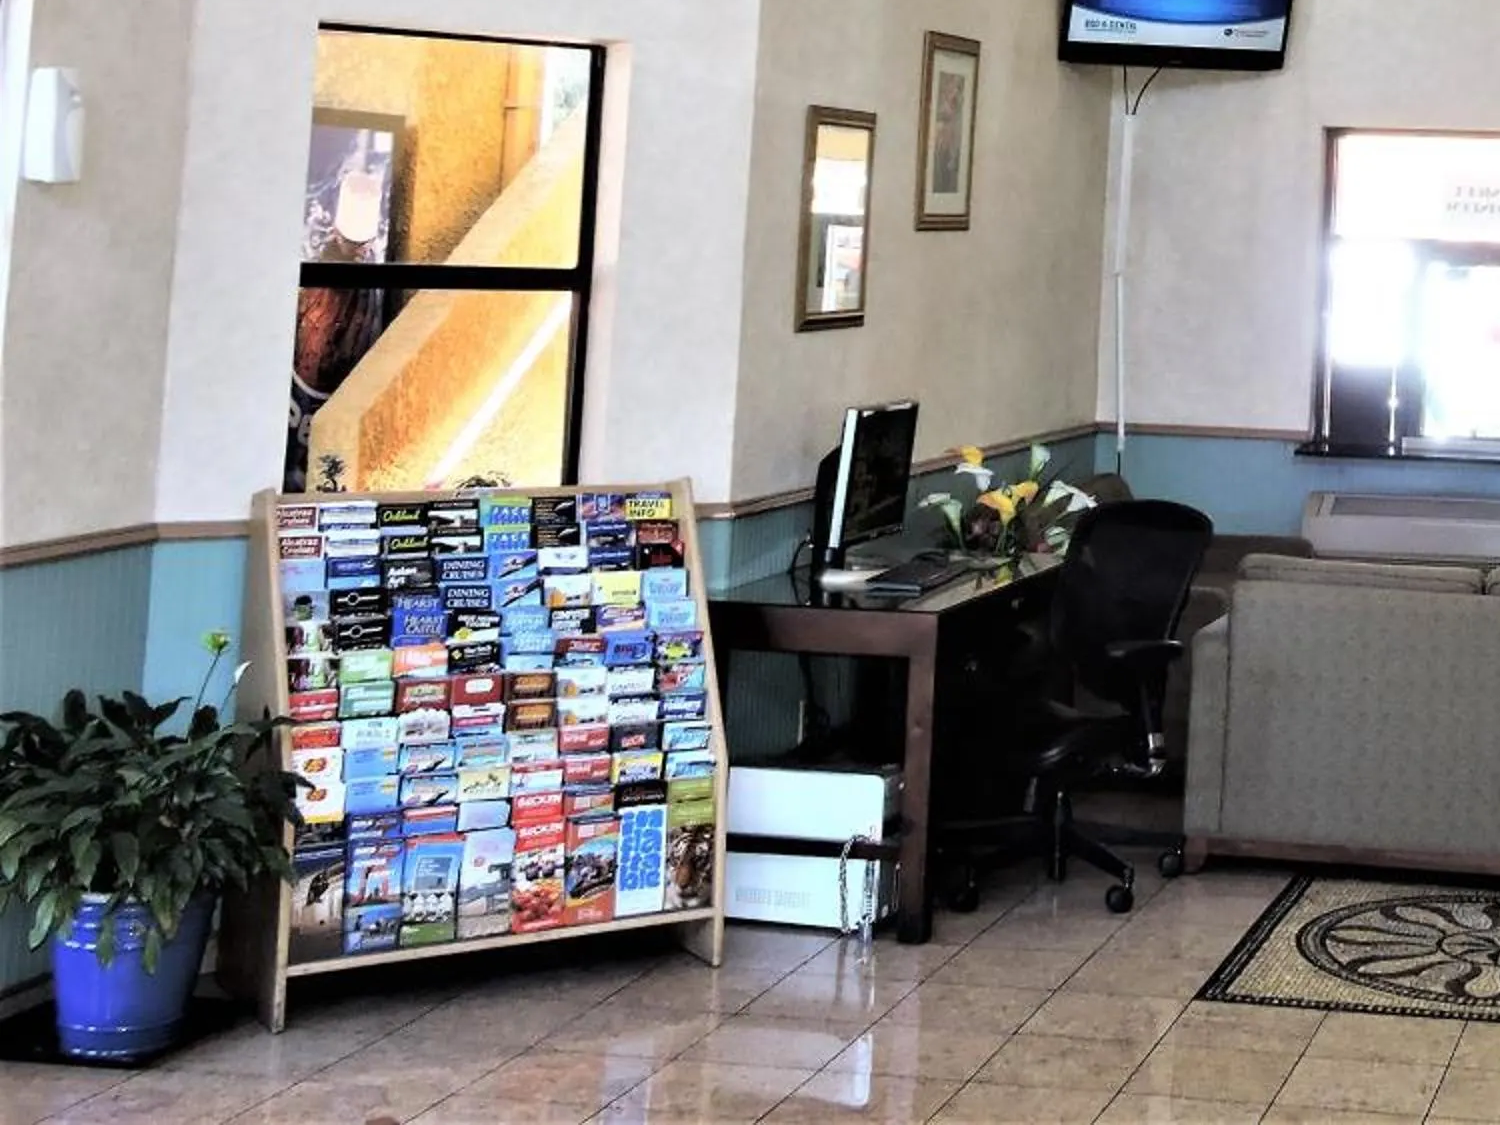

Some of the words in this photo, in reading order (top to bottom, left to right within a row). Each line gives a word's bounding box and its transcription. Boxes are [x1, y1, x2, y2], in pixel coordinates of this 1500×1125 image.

[443, 560, 485, 570] DINING
[442, 570, 485, 580] CRUISES
[447, 588, 489, 598] DINING
[446, 598, 489, 608] CRUISES
